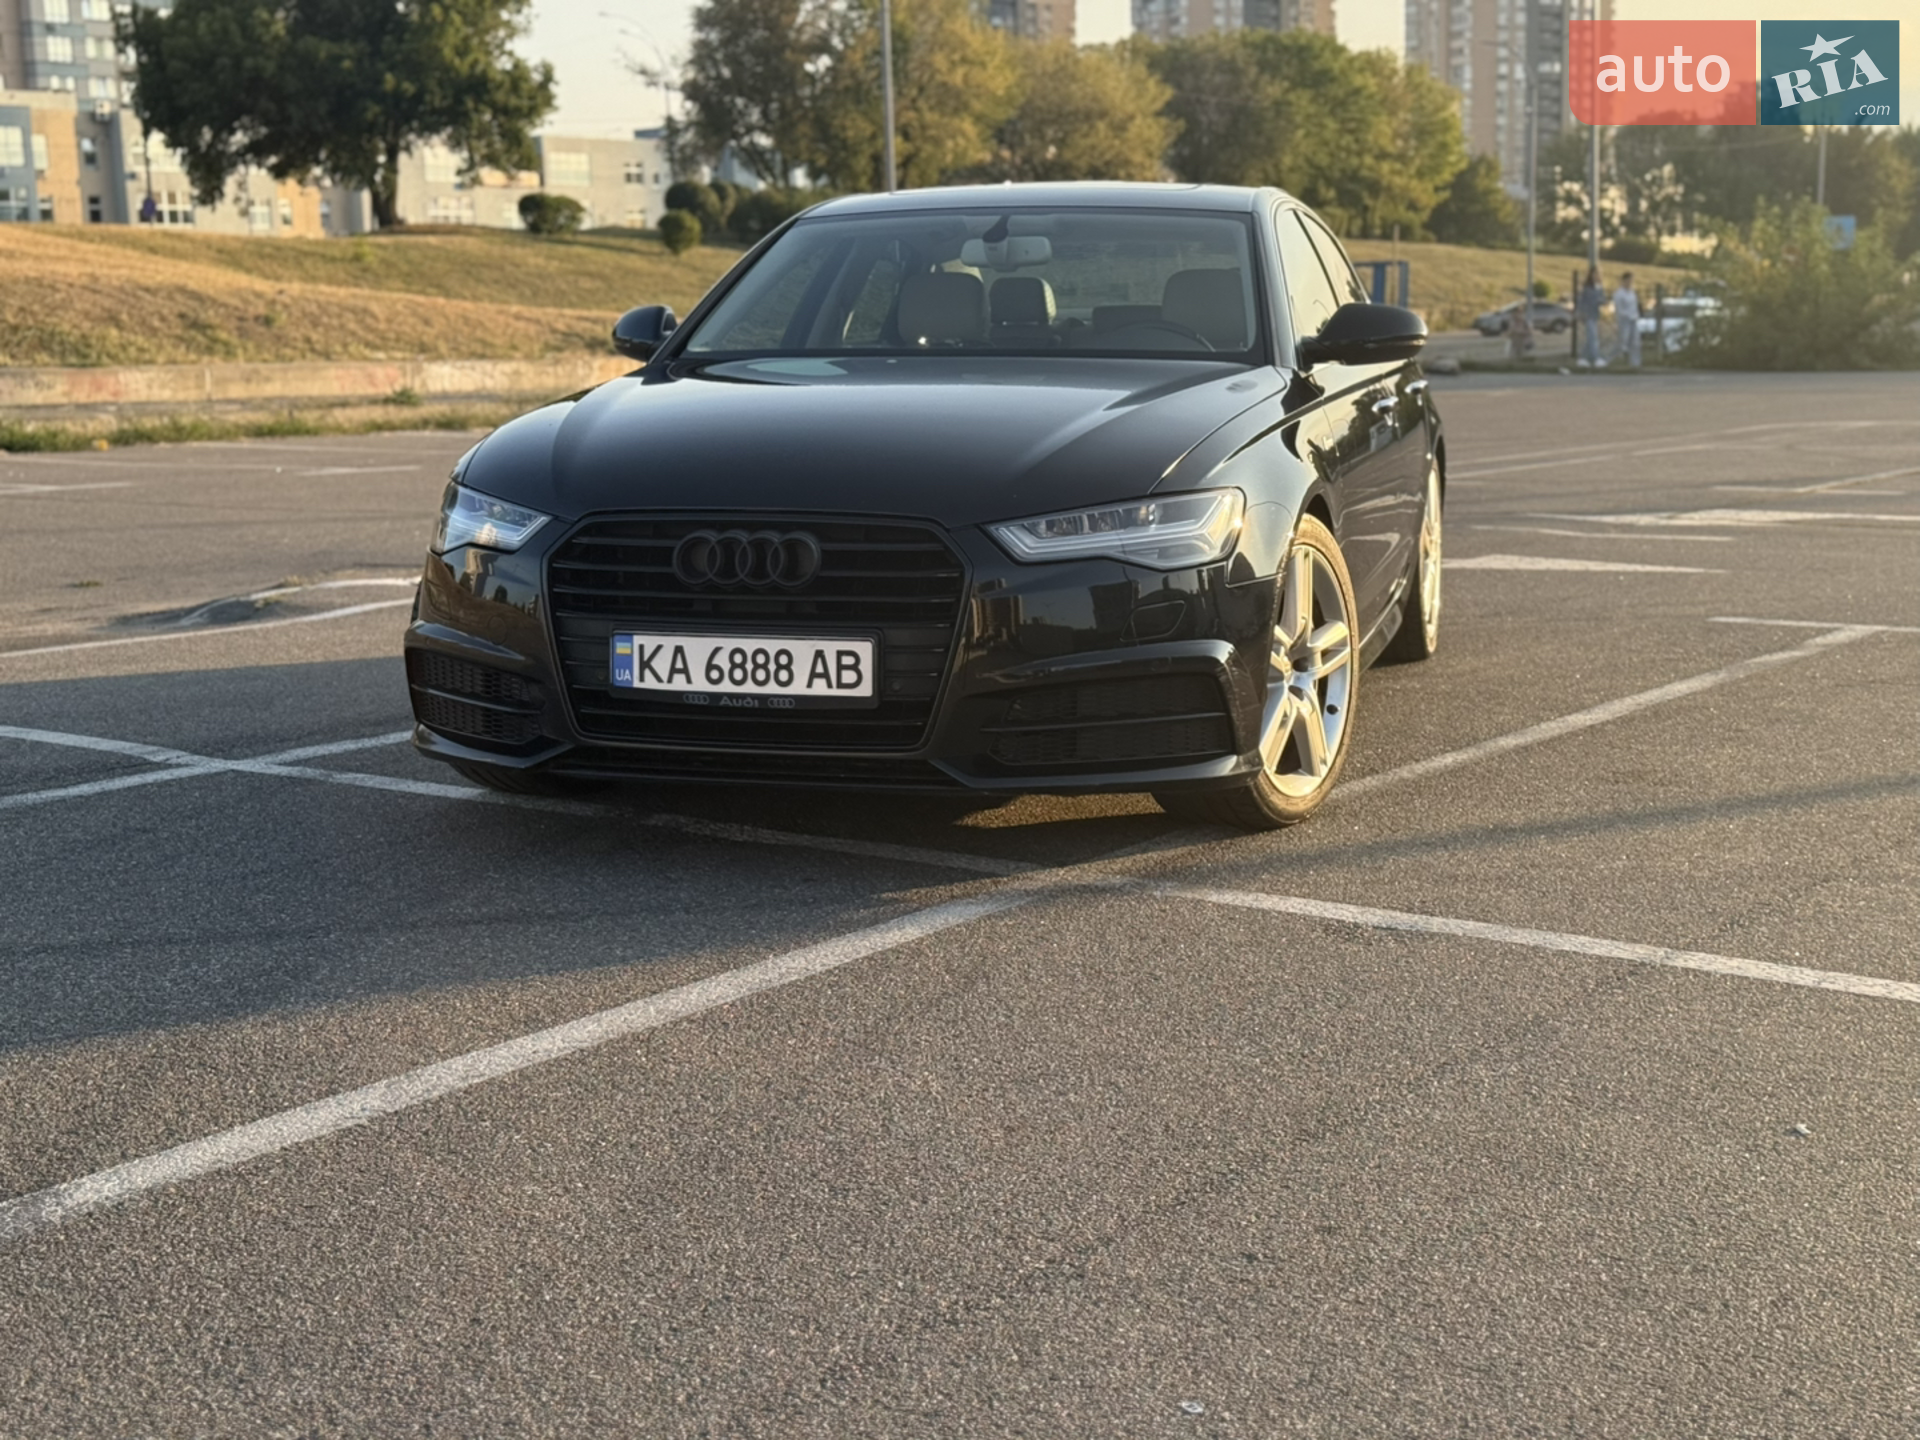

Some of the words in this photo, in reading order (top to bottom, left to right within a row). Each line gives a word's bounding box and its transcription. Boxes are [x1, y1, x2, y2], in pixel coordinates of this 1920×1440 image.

[638, 643, 693, 685] KA
[704, 646, 795, 688] 6888
[806, 648, 864, 690] AB
[615, 668, 632, 682] UA
[719, 695, 760, 708] Audi
